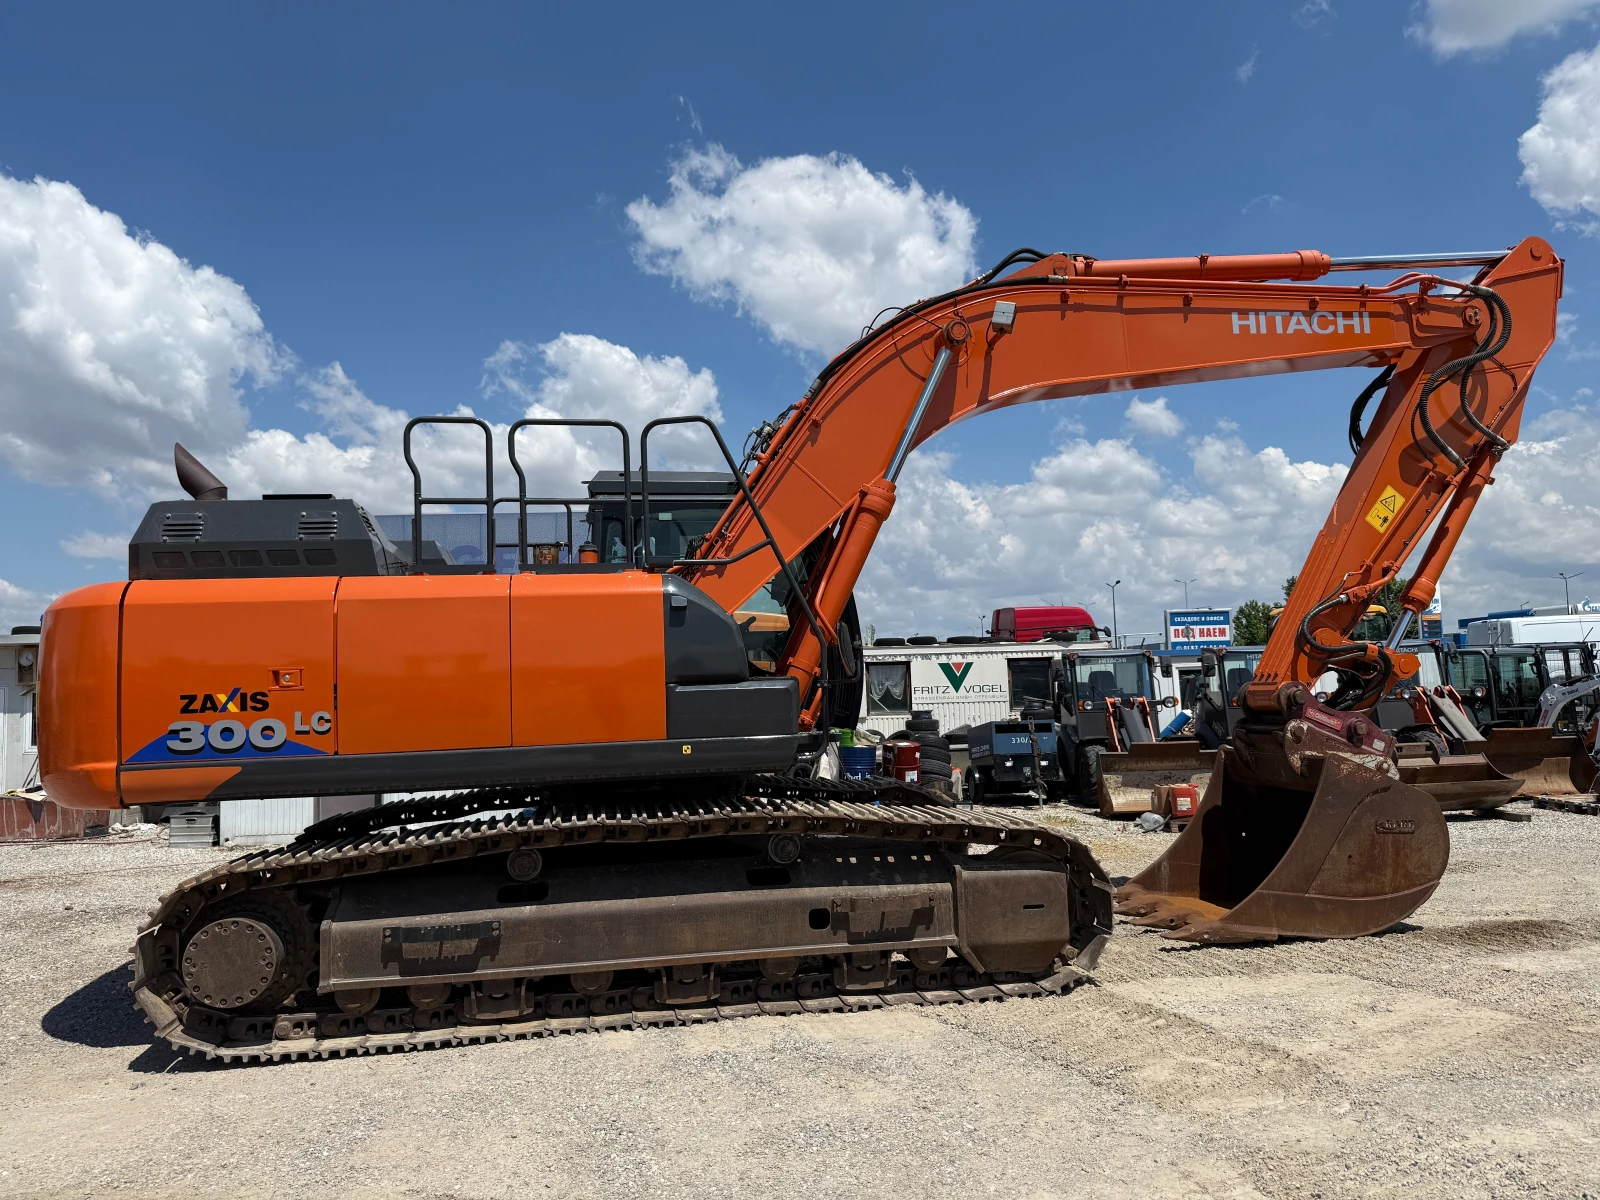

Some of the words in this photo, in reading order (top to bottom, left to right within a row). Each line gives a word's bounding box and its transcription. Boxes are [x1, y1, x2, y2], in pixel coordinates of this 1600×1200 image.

[1231, 311, 1371, 335] HITACHI
[1198, 627, 1227, 638] НАЕМ
[179, 687, 270, 714] ZAXIS
[913, 685, 951, 695] FRITZ
[963, 684, 1007, 694] VOGEL
[166, 718, 287, 755] 300
[294, 710, 332, 736] LC
